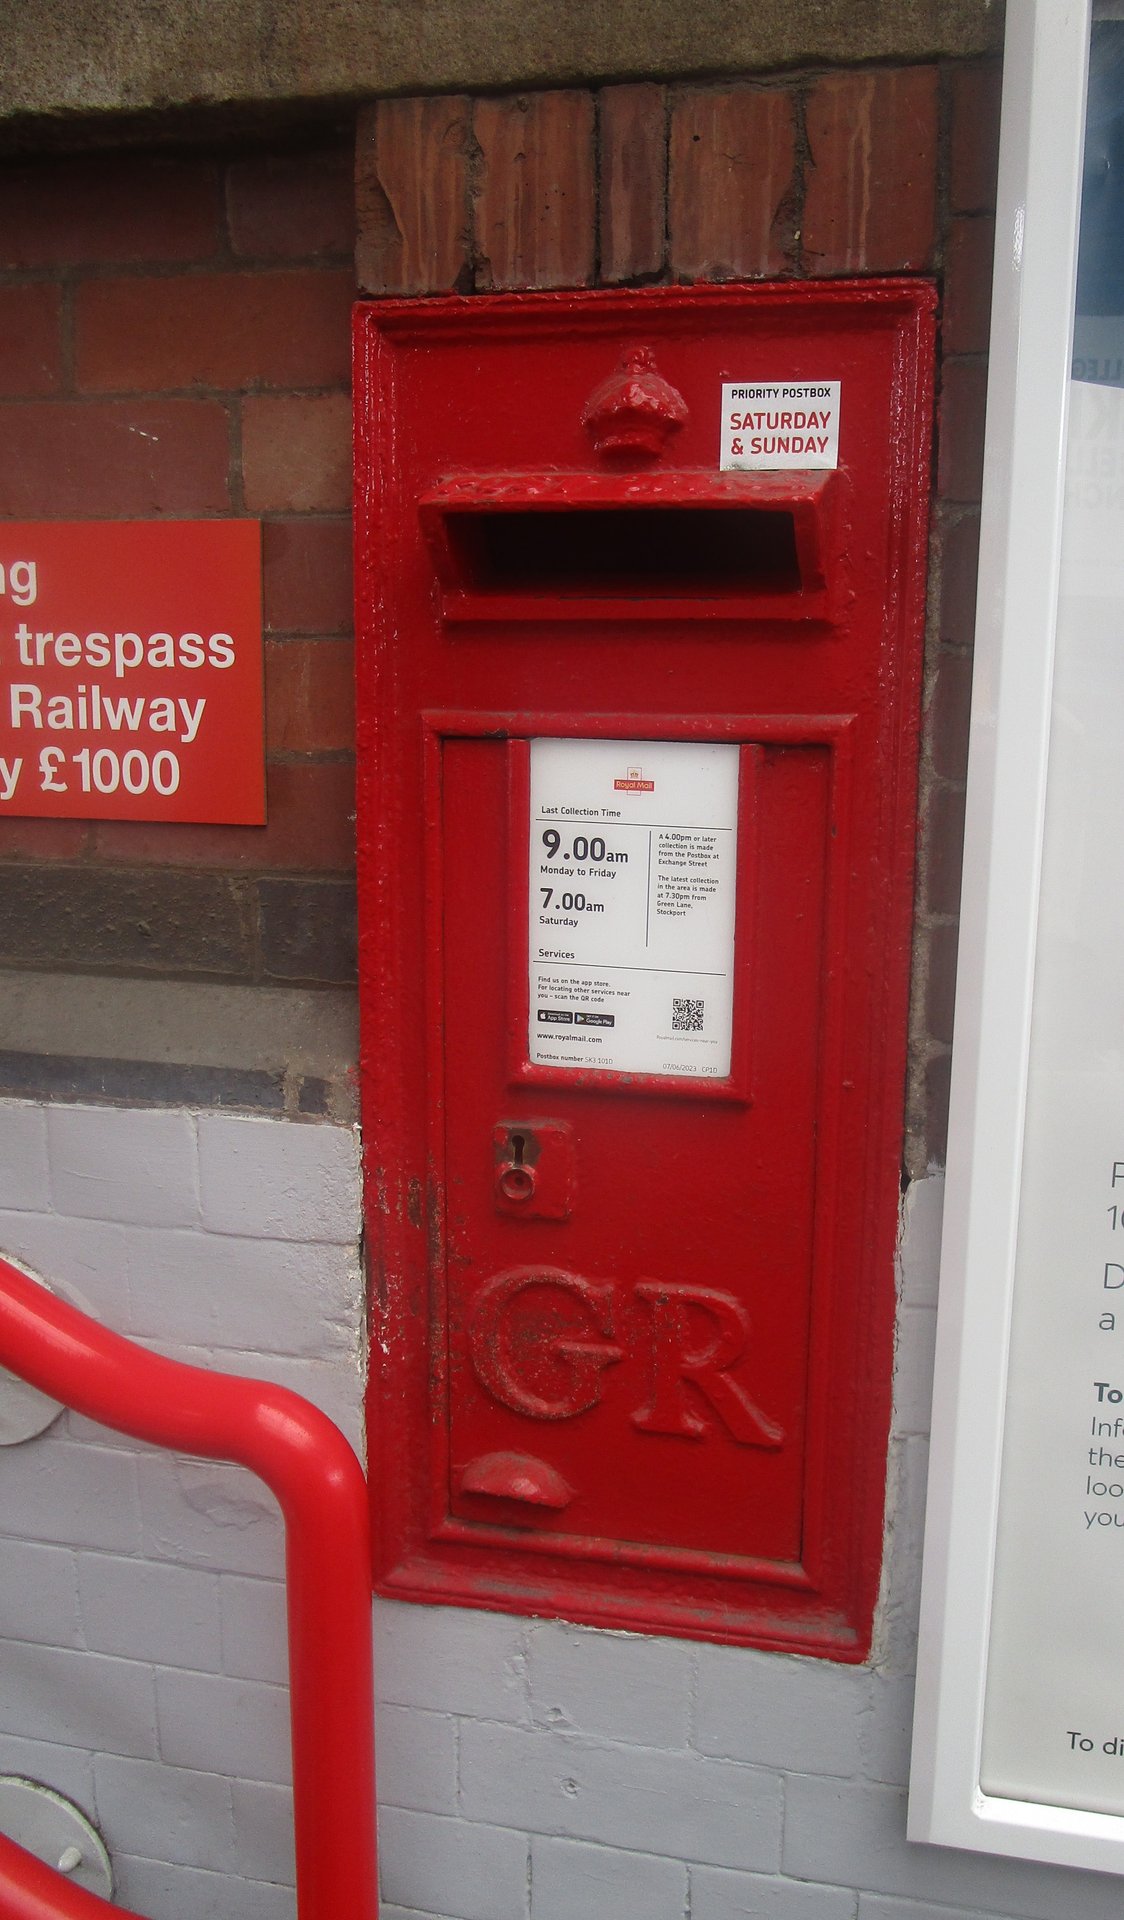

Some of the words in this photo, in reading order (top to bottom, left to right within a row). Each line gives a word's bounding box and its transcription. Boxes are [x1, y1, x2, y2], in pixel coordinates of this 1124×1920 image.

[731, 388, 780, 399] PRIORITY
[782, 388, 831, 398] POSTBOX
[730, 411, 831, 430] SATURDAY
[730, 438, 744, 454] &
[750, 436, 829, 454] SUNDAY
[15, 623, 236, 678] trespass
[10, 684, 206, 743] Railway
[39, 746, 180, 796] £1000
[616, 781, 636, 789] Royal
[541, 806, 558, 814] Last
[560, 807, 598, 816] Collection
[601, 808, 621, 818] Time
[665, 834, 692, 842] 4.00pm
[542, 829, 628, 863] 9.00am
[540, 865, 574, 876] Monday
[577, 868, 586, 876] to
[589, 868, 616, 879] Friday
[540, 888, 604, 912] 7.00am
[665, 892, 690, 900] 7.30pm
[656, 908, 686, 916] Stockport
[539, 916, 579, 928] Saturday
[538, 948, 575, 959] Services
[549, 985, 572, 993] locating
[536, 1033, 602, 1043] www.royalmail.com
[662, 1064, 696, 1072] 07/06/2023
[1099, 1312, 1116, 1331] a
[1093, 1382, 1124, 1404] To
[1066, 1731, 1094, 1751] To
